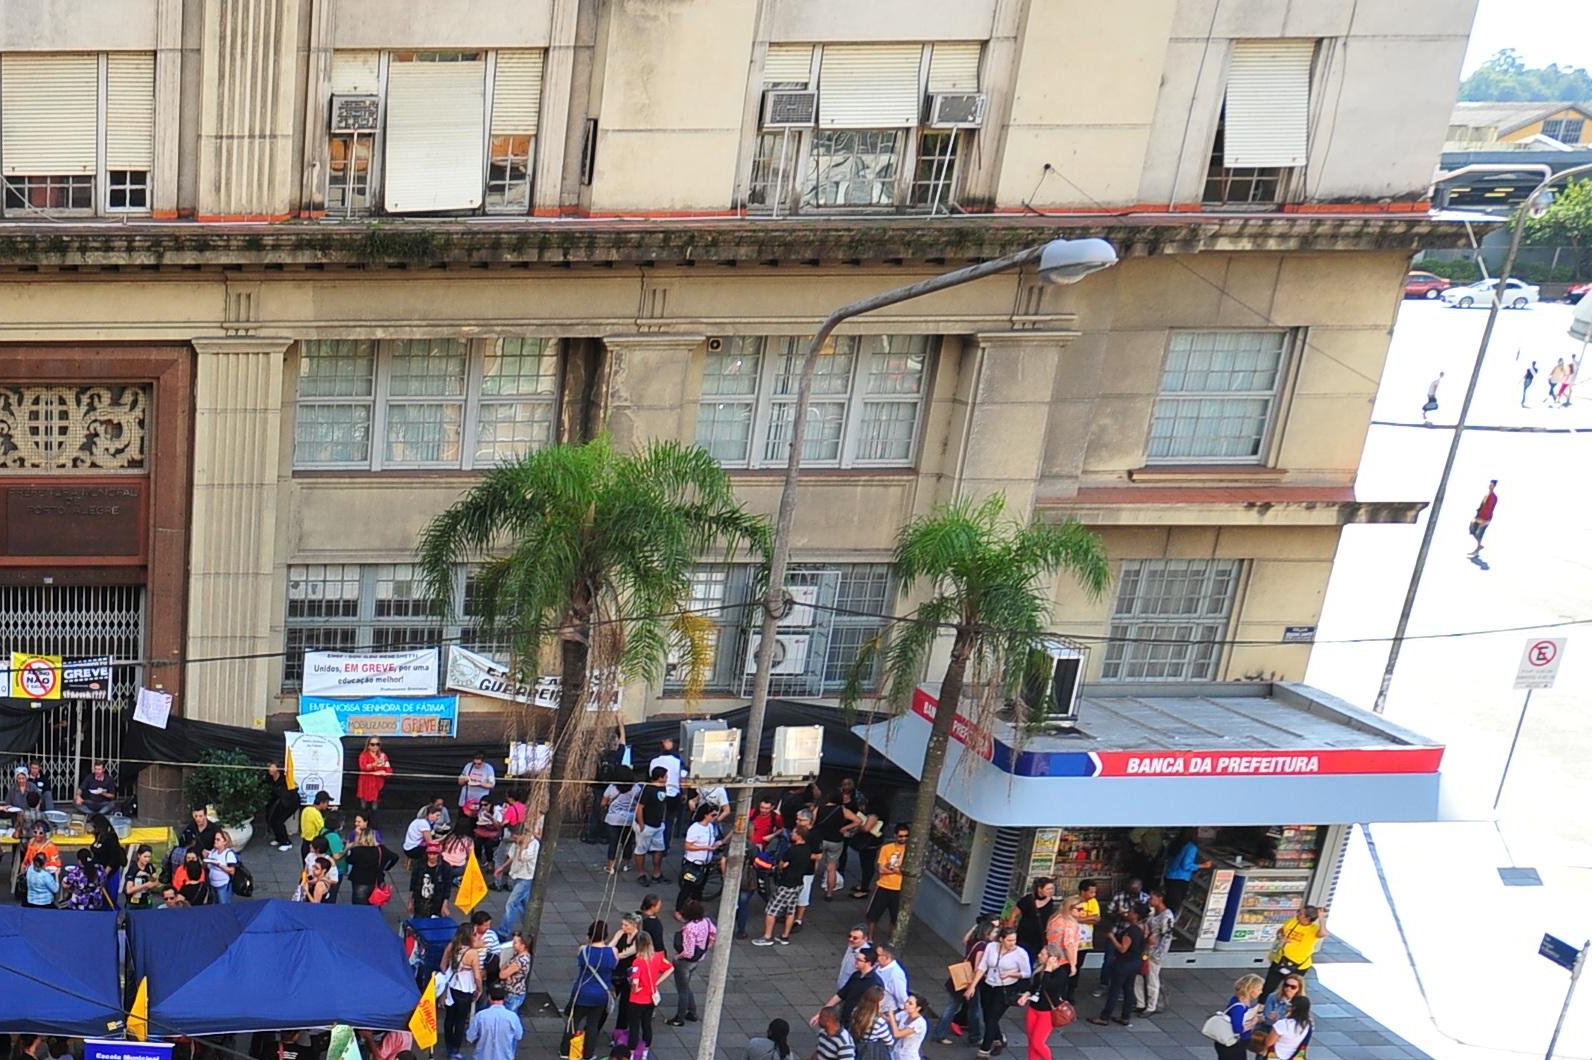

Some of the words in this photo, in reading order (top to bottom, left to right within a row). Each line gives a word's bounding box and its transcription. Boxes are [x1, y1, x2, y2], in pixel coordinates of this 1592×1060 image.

[314, 664, 342, 673] Unidos,
[344, 663, 358, 673] EM
[361, 663, 397, 673] GREVE,
[398, 664, 412, 673] por
[64, 667, 108, 680] GREVE
[338, 676, 374, 685] educação
[375, 675, 404, 684] melhor!
[334, 702, 361, 712] NOSSA
[362, 702, 402, 712] SENHORA
[403, 703, 414, 712] DE
[1126, 757, 1184, 774] BANCA
[1189, 756, 1212, 773] DA
[1216, 755, 1319, 773] PREFEITURA
